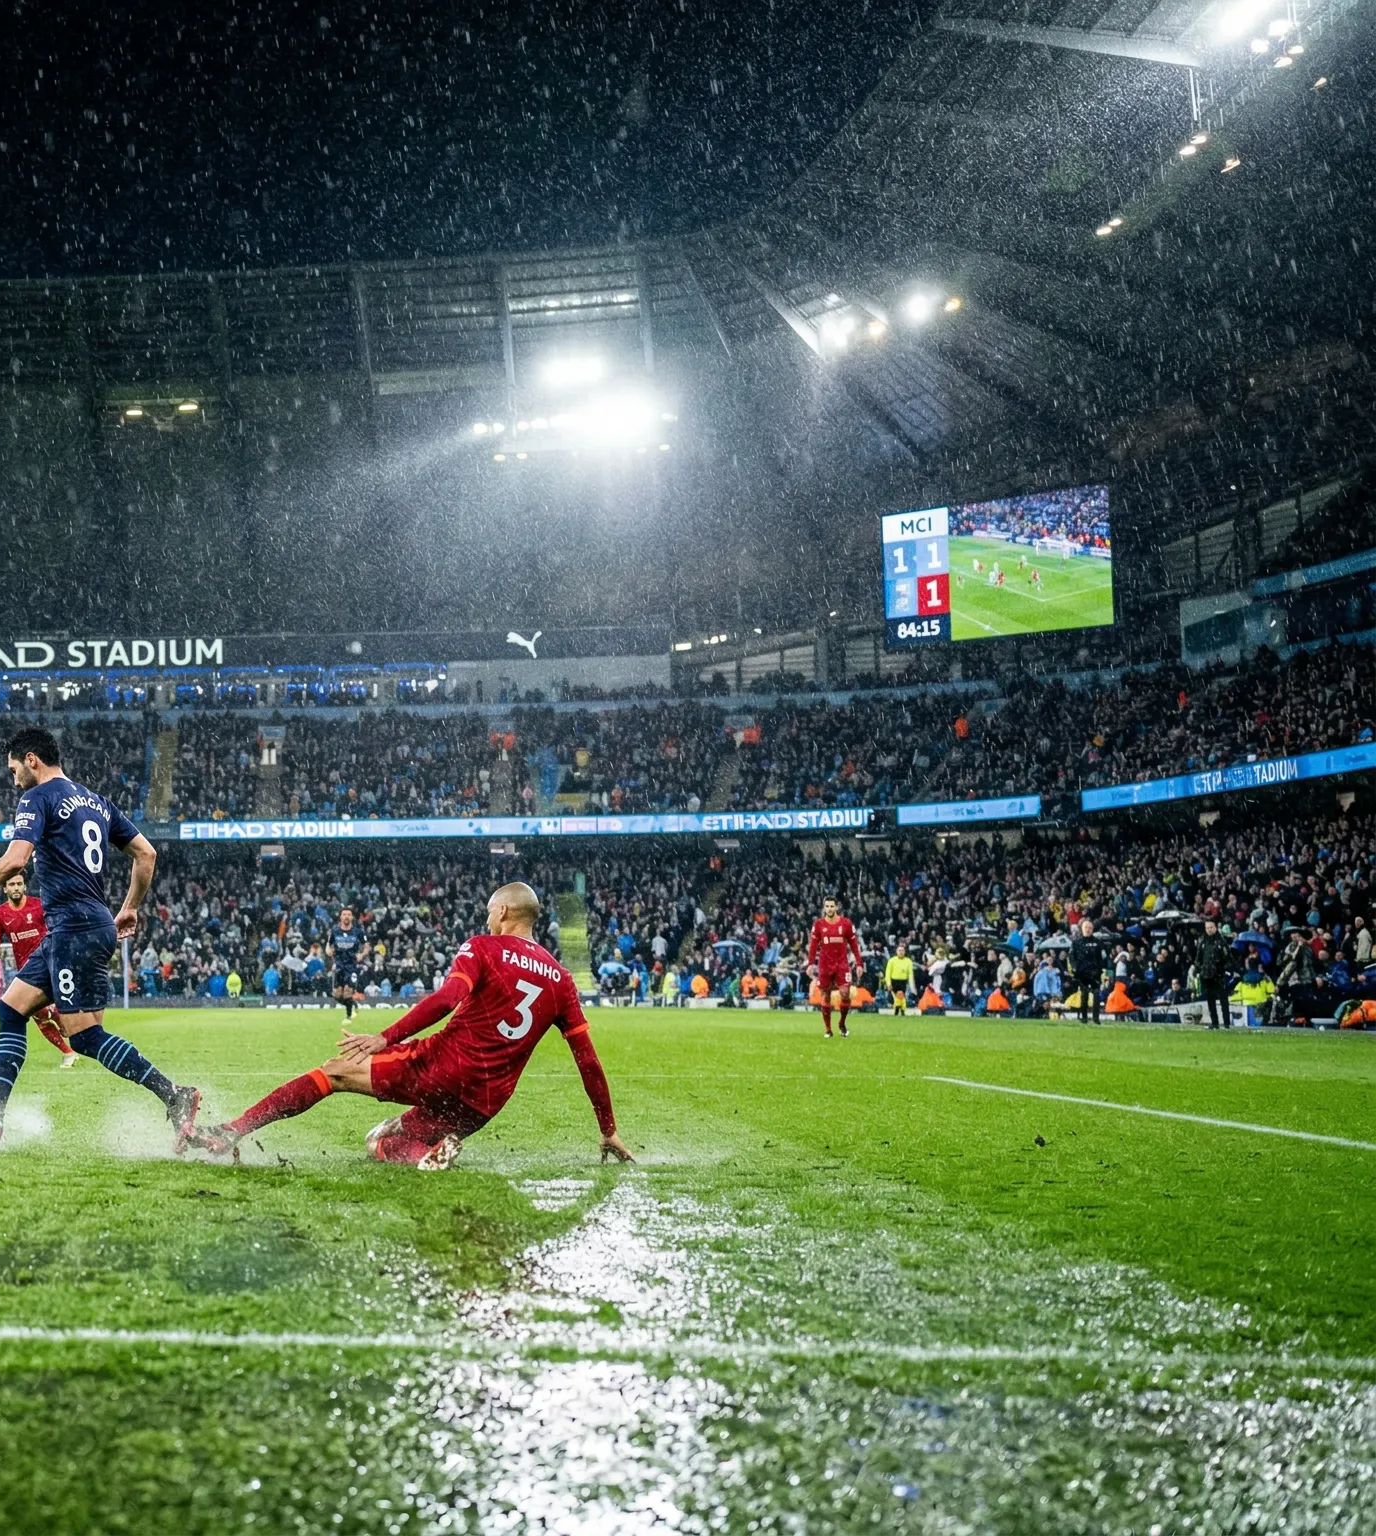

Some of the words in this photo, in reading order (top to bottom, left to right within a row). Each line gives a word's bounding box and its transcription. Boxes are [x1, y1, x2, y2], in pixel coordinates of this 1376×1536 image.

[900, 517, 932, 535] MCI
[893, 547, 908, 574] 1
[927, 542, 942, 569] 1
[926, 579, 942, 608] 1
[897, 620, 941, 639] 84:15
[68, 638, 224, 668] STADIUM
[180, 822, 265, 840] ETIHAD
[271, 821, 354, 838] STADIUM
[81, 819, 103, 874] 8
[502, 949, 562, 983] FABINHO
[58, 968, 75, 996] 8
[496, 978, 544, 1040] 3
